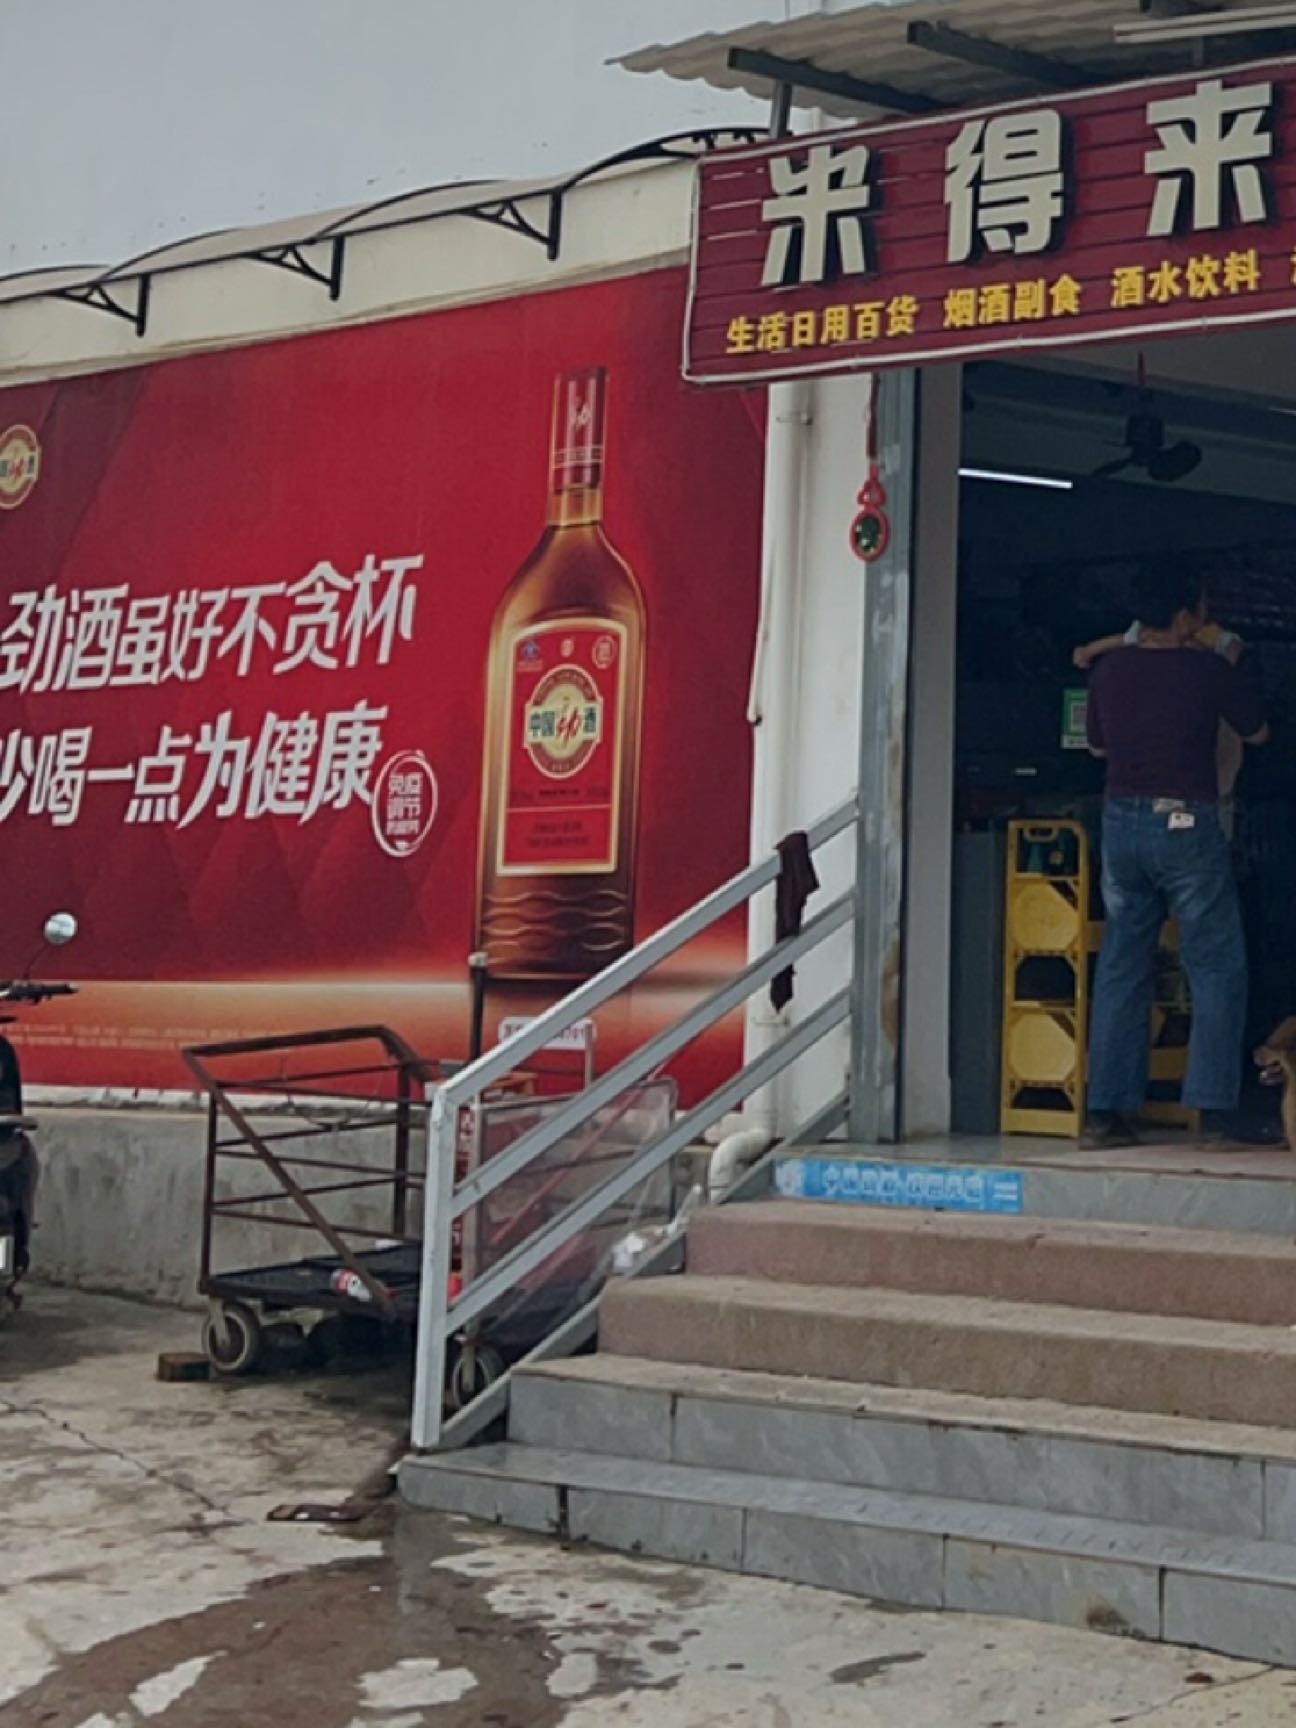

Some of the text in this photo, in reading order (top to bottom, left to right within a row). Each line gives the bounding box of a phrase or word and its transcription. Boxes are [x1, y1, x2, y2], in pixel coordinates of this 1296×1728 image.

[726, 293, 919, 354] 生活日用百货
[943, 274, 1082, 328] 烟酒副食
[1110, 248, 1262, 308] 酒水饮料
[0, 554, 424, 695] 劲酒虽好不贪杯
[0, 698, 388, 829] 少喝一点为健康
